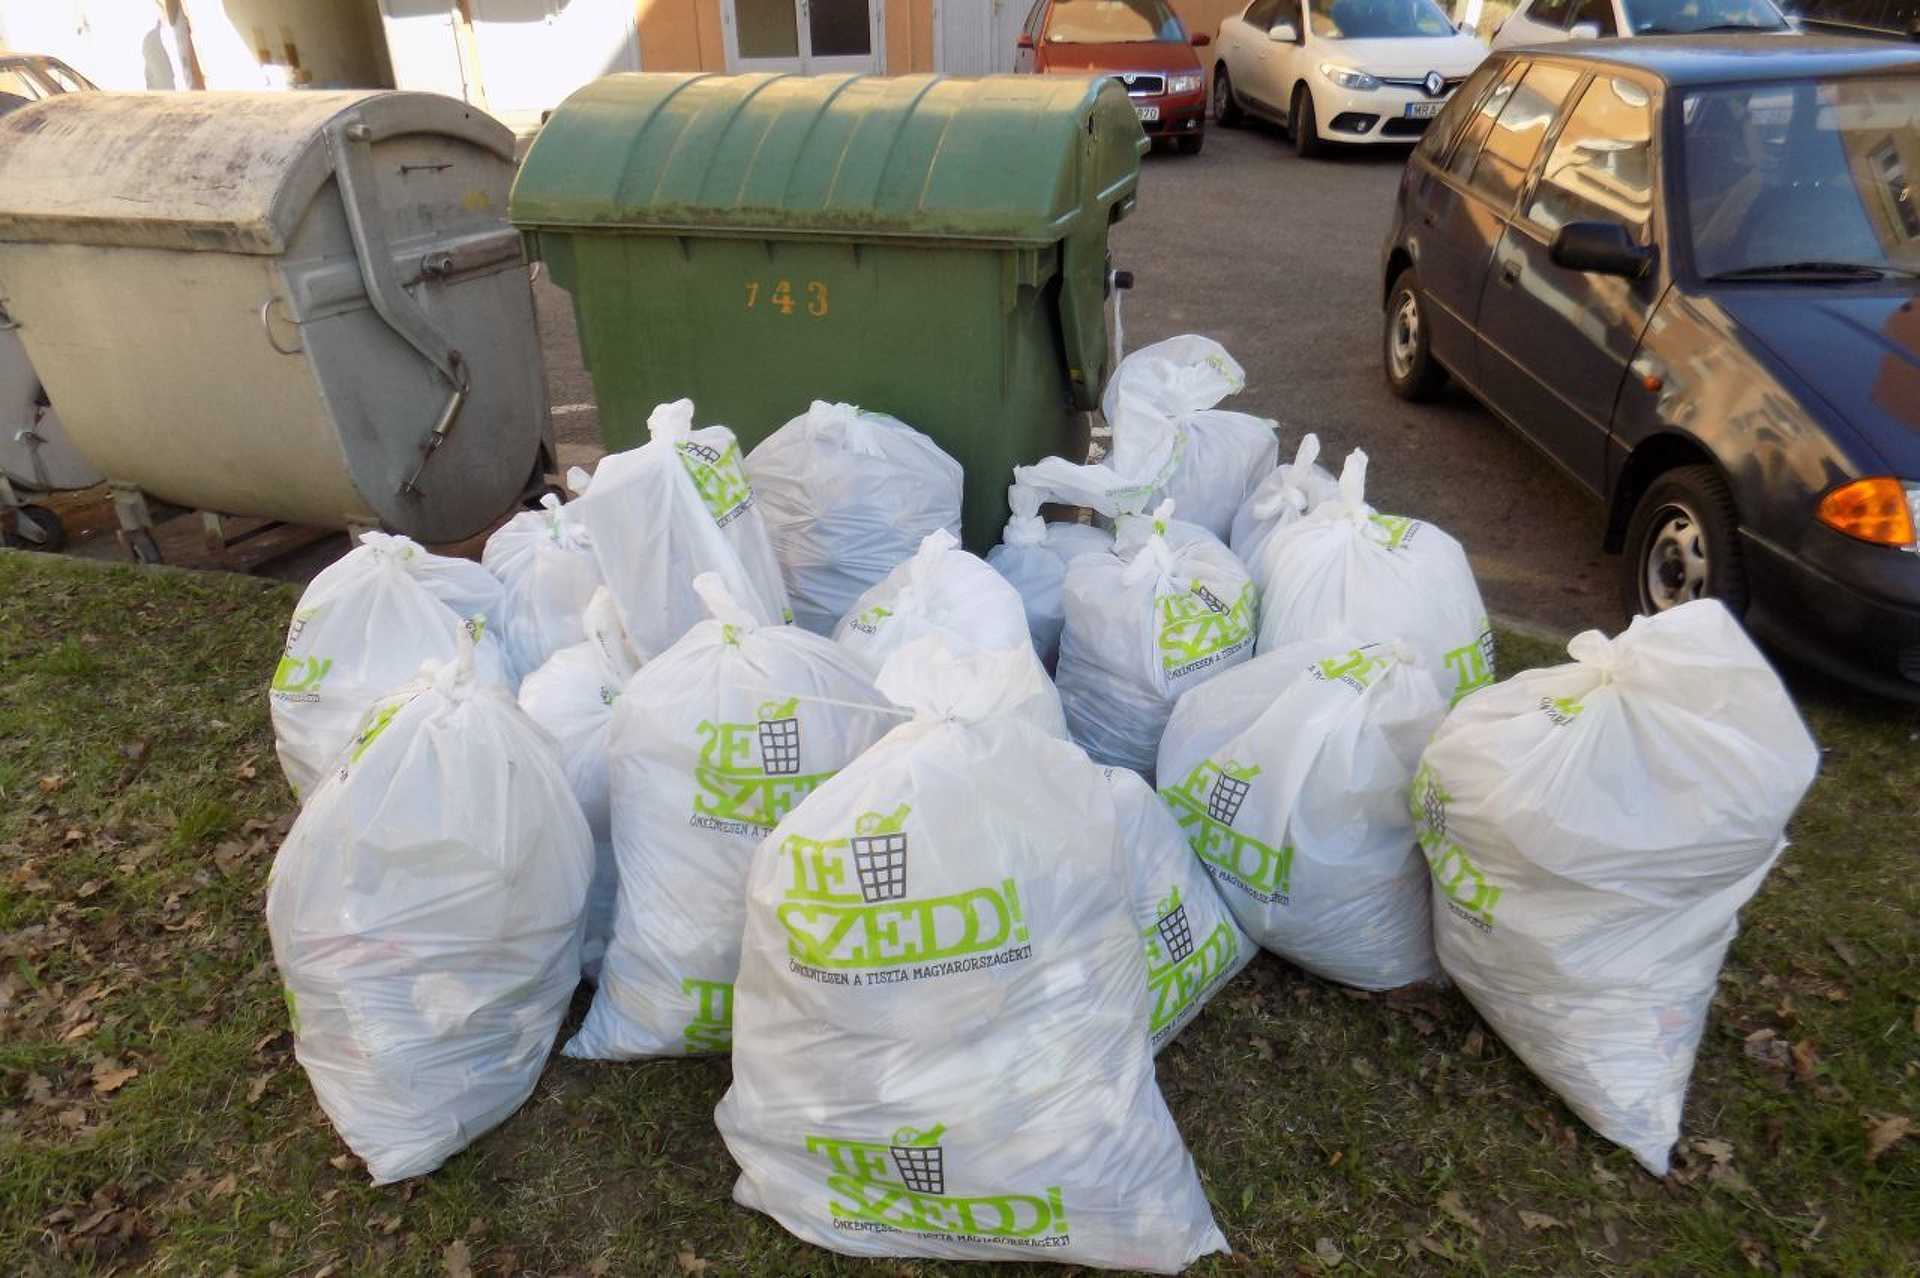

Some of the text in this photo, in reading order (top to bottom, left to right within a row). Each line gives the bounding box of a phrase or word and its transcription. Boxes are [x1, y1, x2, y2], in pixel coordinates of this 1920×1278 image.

[779, 833, 863, 903] TE
[776, 876, 1030, 968] SZEDD!
[853, 972, 863, 986] A
[865, 968, 909, 985] TISZTA
[828, 1186, 1070, 1236] SZEDD!
